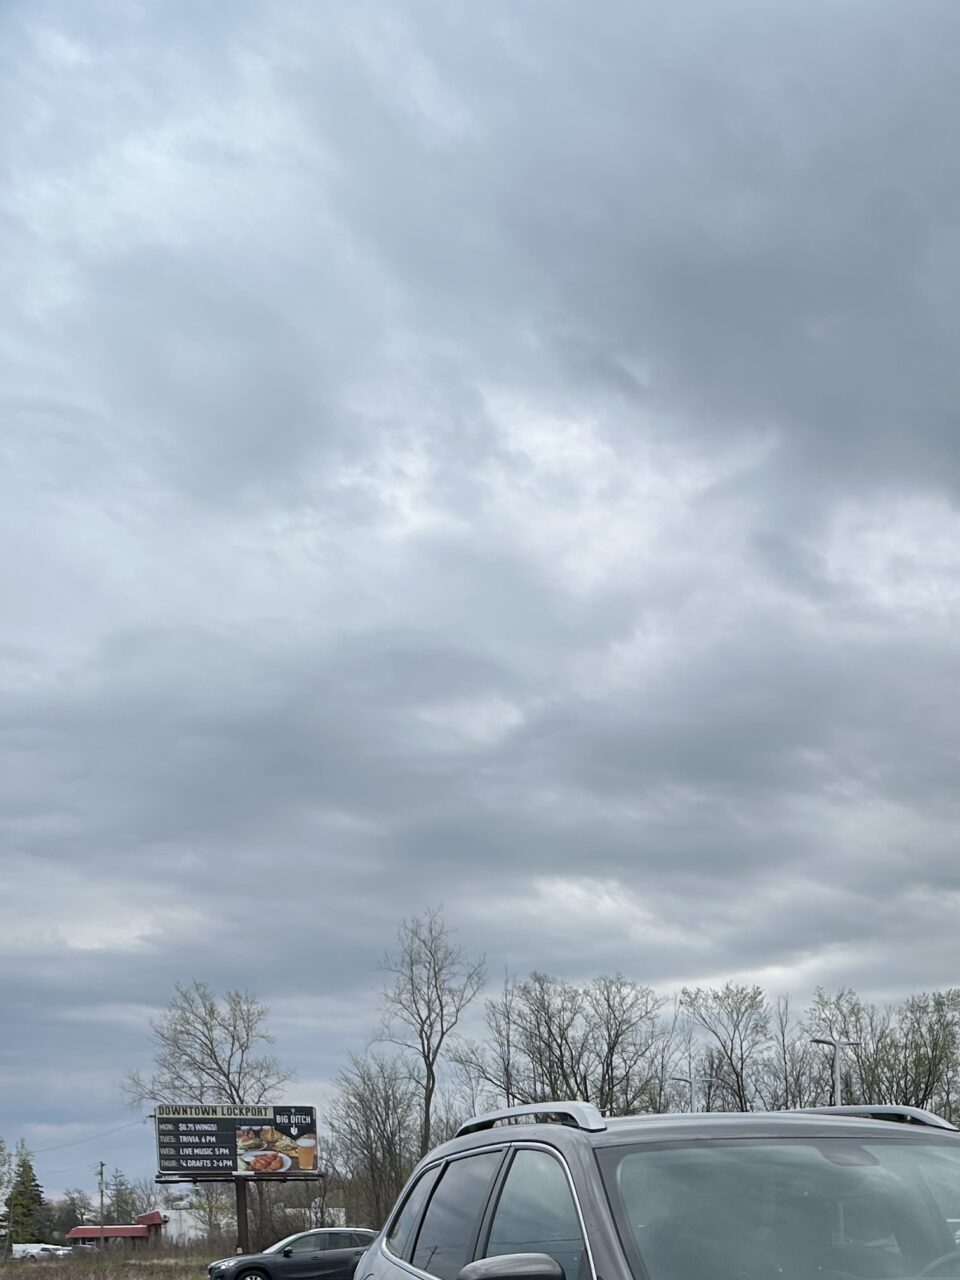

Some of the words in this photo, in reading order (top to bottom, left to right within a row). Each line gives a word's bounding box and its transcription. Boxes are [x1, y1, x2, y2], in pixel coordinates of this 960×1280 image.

[159, 1106, 218, 1116] DOWNTOWN
[221, 1106, 268, 1117] LOCKPORT
[276, 1115, 289, 1124] BIG
[290, 1115, 311, 1124] DITCH
